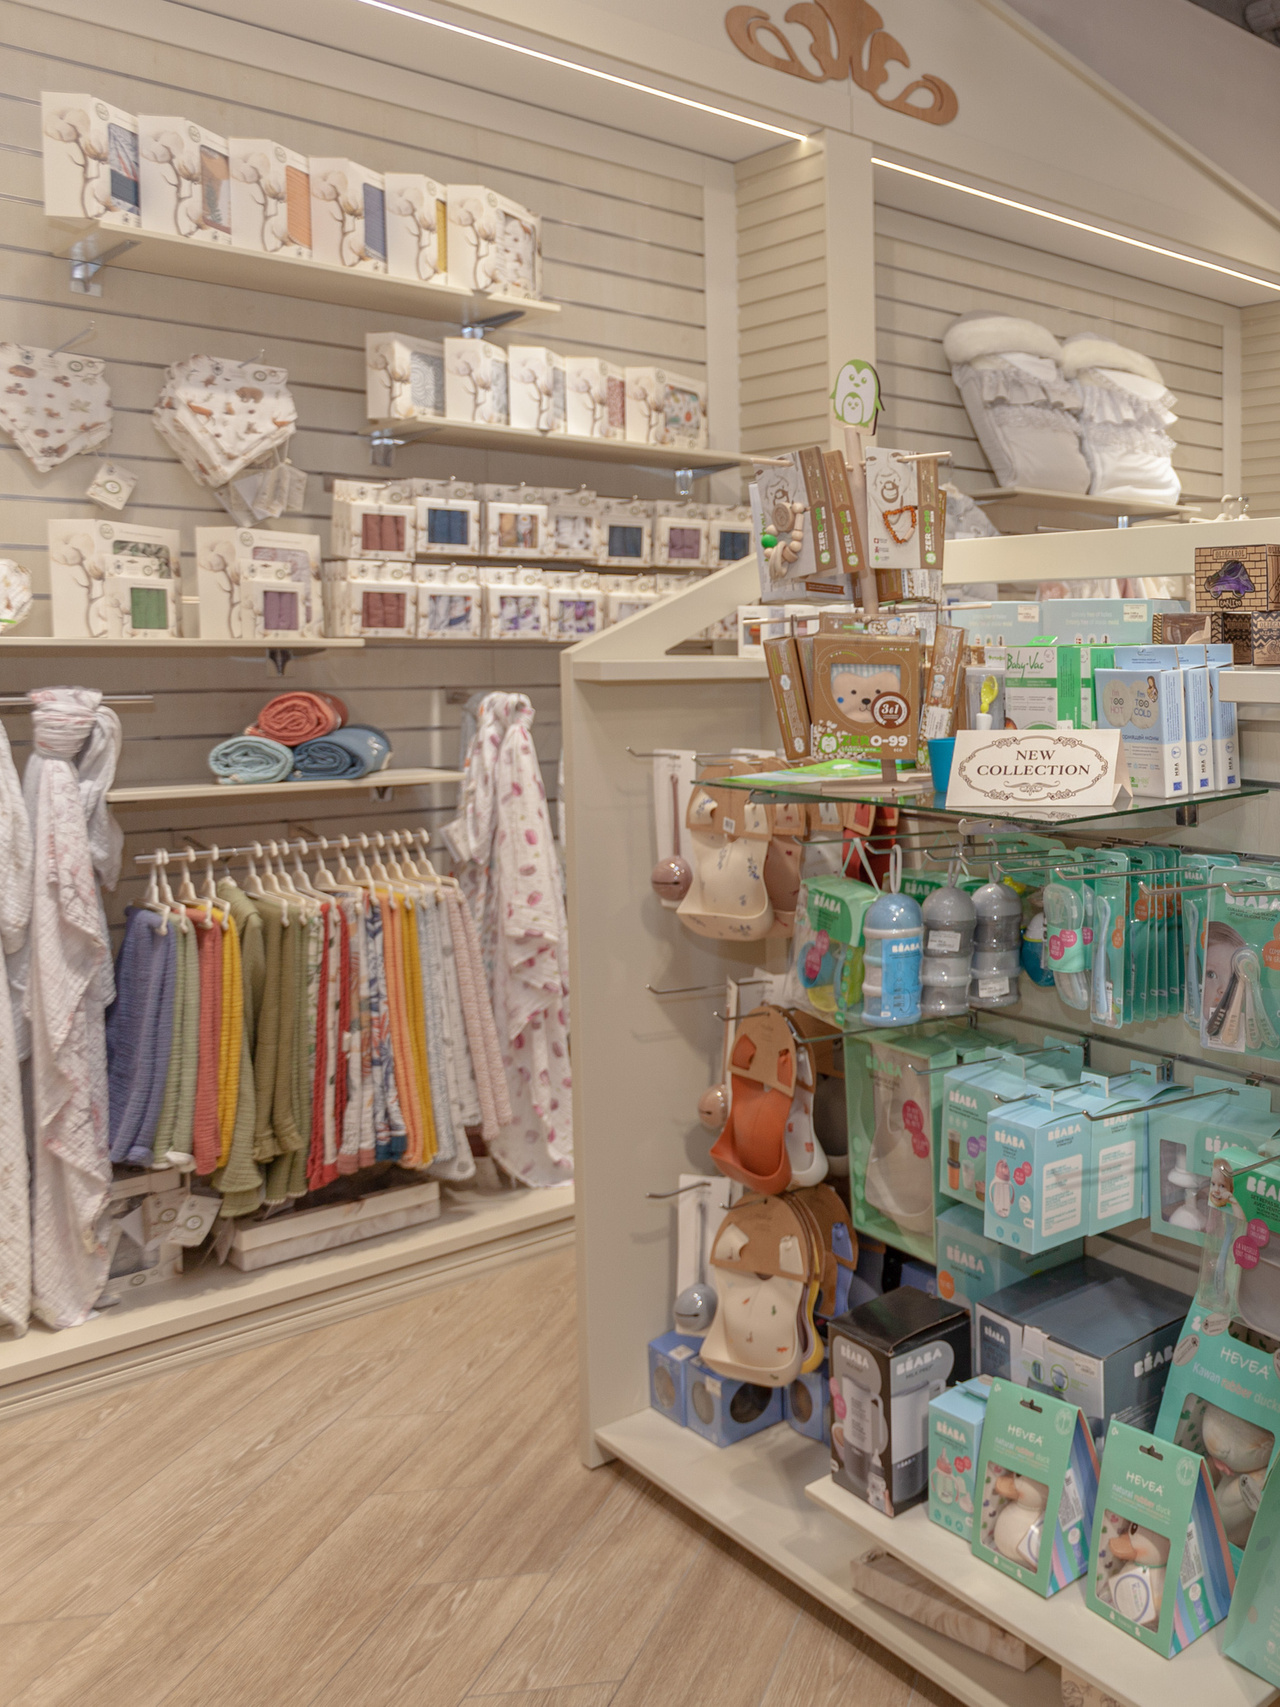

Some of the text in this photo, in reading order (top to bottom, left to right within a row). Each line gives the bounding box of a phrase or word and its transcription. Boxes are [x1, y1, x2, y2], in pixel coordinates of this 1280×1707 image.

[1133, 707, 1152, 718] COLD
[841, 735, 908, 747] ZERO-99
[1015, 750, 1056, 761] NEW
[976, 764, 1091, 776] COLLECTION
[892, 942, 920, 953] BÉABA
[994, 1129, 1025, 1150] BÉABA
[1048, 1124, 1081, 1141] BÉABA
[896, 1347, 942, 1376] BÉABA
[1134, 1345, 1174, 1378] BÉAB
[1220, 1346, 1270, 1380] HEVEA
[1192, 1362, 1220, 1385] Kawan
[1220, 1378, 1253, 1399] rubber
[1007, 1424, 1044, 1447] HEVEA
[1126, 1470, 1163, 1496] HEVEA
